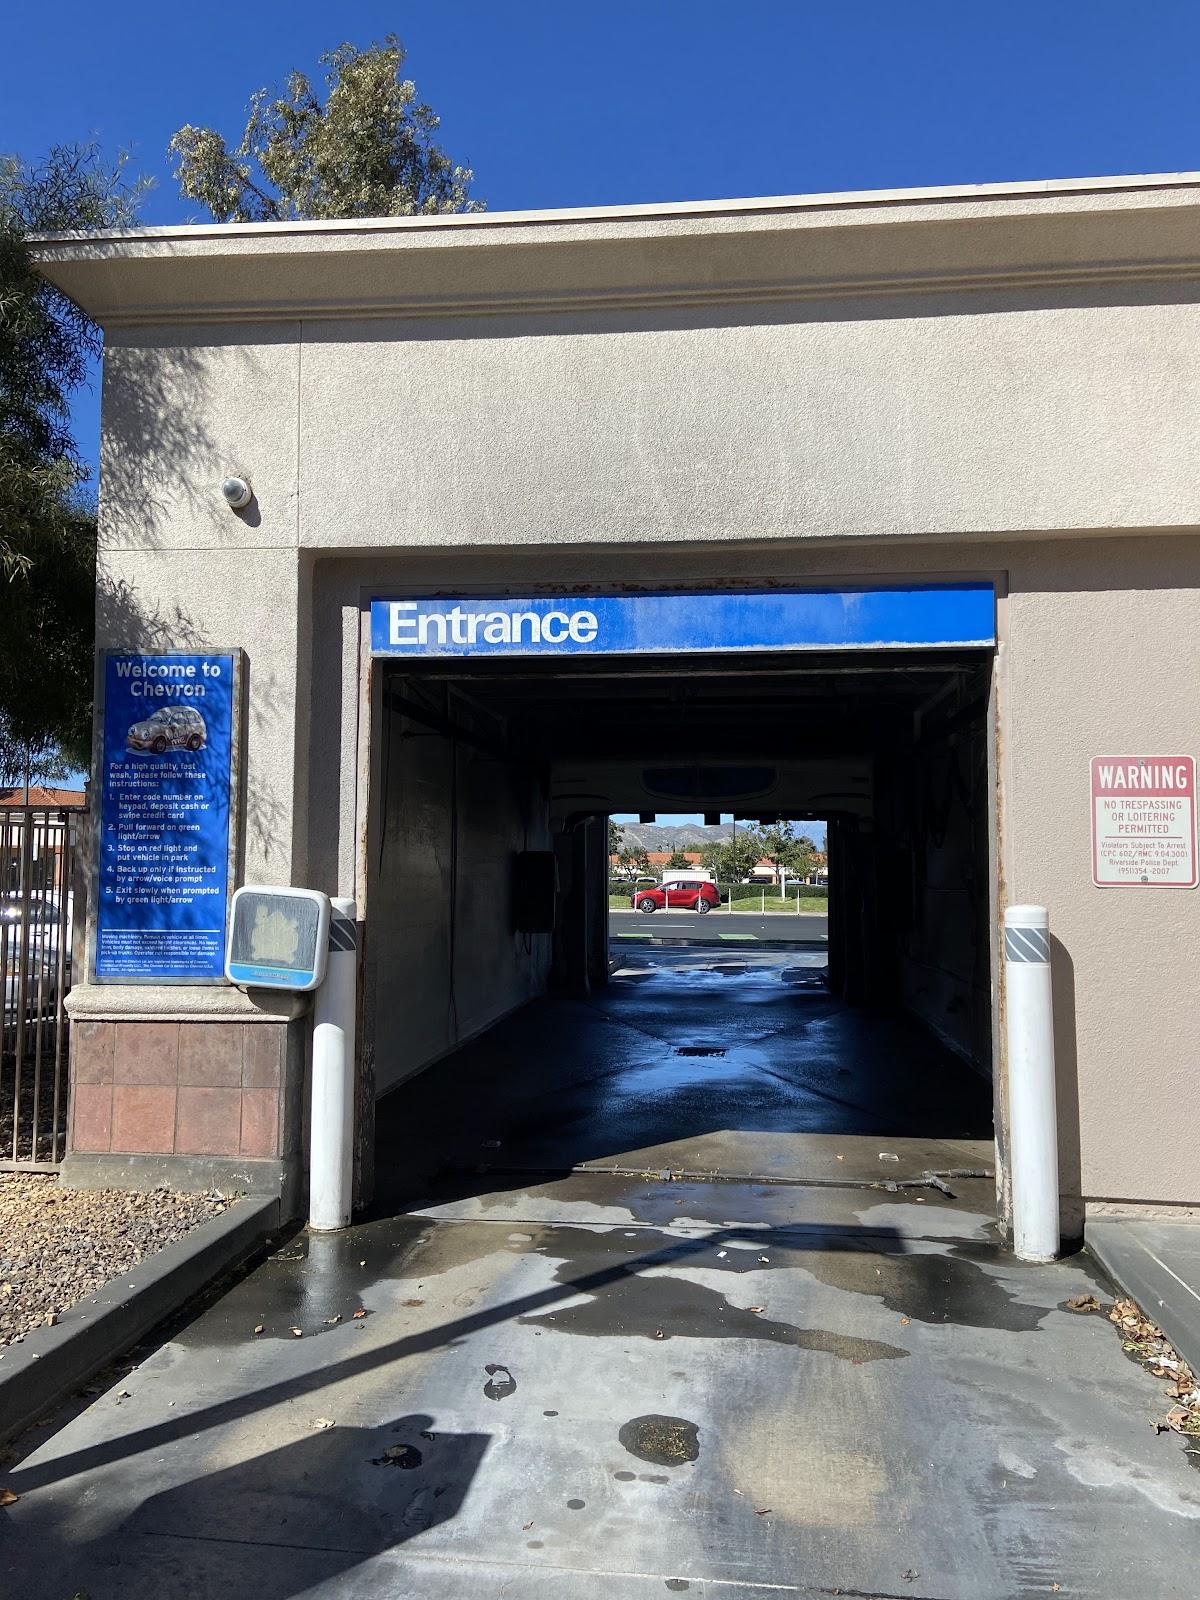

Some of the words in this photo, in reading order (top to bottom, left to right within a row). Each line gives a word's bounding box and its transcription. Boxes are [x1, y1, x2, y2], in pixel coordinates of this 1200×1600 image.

[388, 602, 598, 645] Entrance
[116, 662, 196, 678] Welcome
[202, 662, 220, 677] to
[130, 681, 205, 696] Chevron
[131, 763, 147, 771] high
[150, 763, 178, 771] quality,
[134, 772, 158, 780] please
[1098, 765, 1187, 789] WARNING
[119, 803, 148, 811] keypad,
[150, 803, 178, 811] deposit
[1104, 801, 1116, 809] NO
[1120, 801, 1182, 809] TRESPASSING
[118, 812, 140, 820] swipe
[1112, 813, 1124, 821] OR
[1128, 813, 1175, 821] LOITERING
[1119, 825, 1169, 833] PERMITTED
[118, 833, 161, 841] light/arrow
[118, 845, 135, 853] Stop
[164, 845, 181, 853] light
[150, 866, 166, 874] only
[117, 875, 125, 883] by
[134, 887, 159, 895] slowly
[182, 887, 219, 895] prompted
[151, 896, 193, 904] light/arrow
